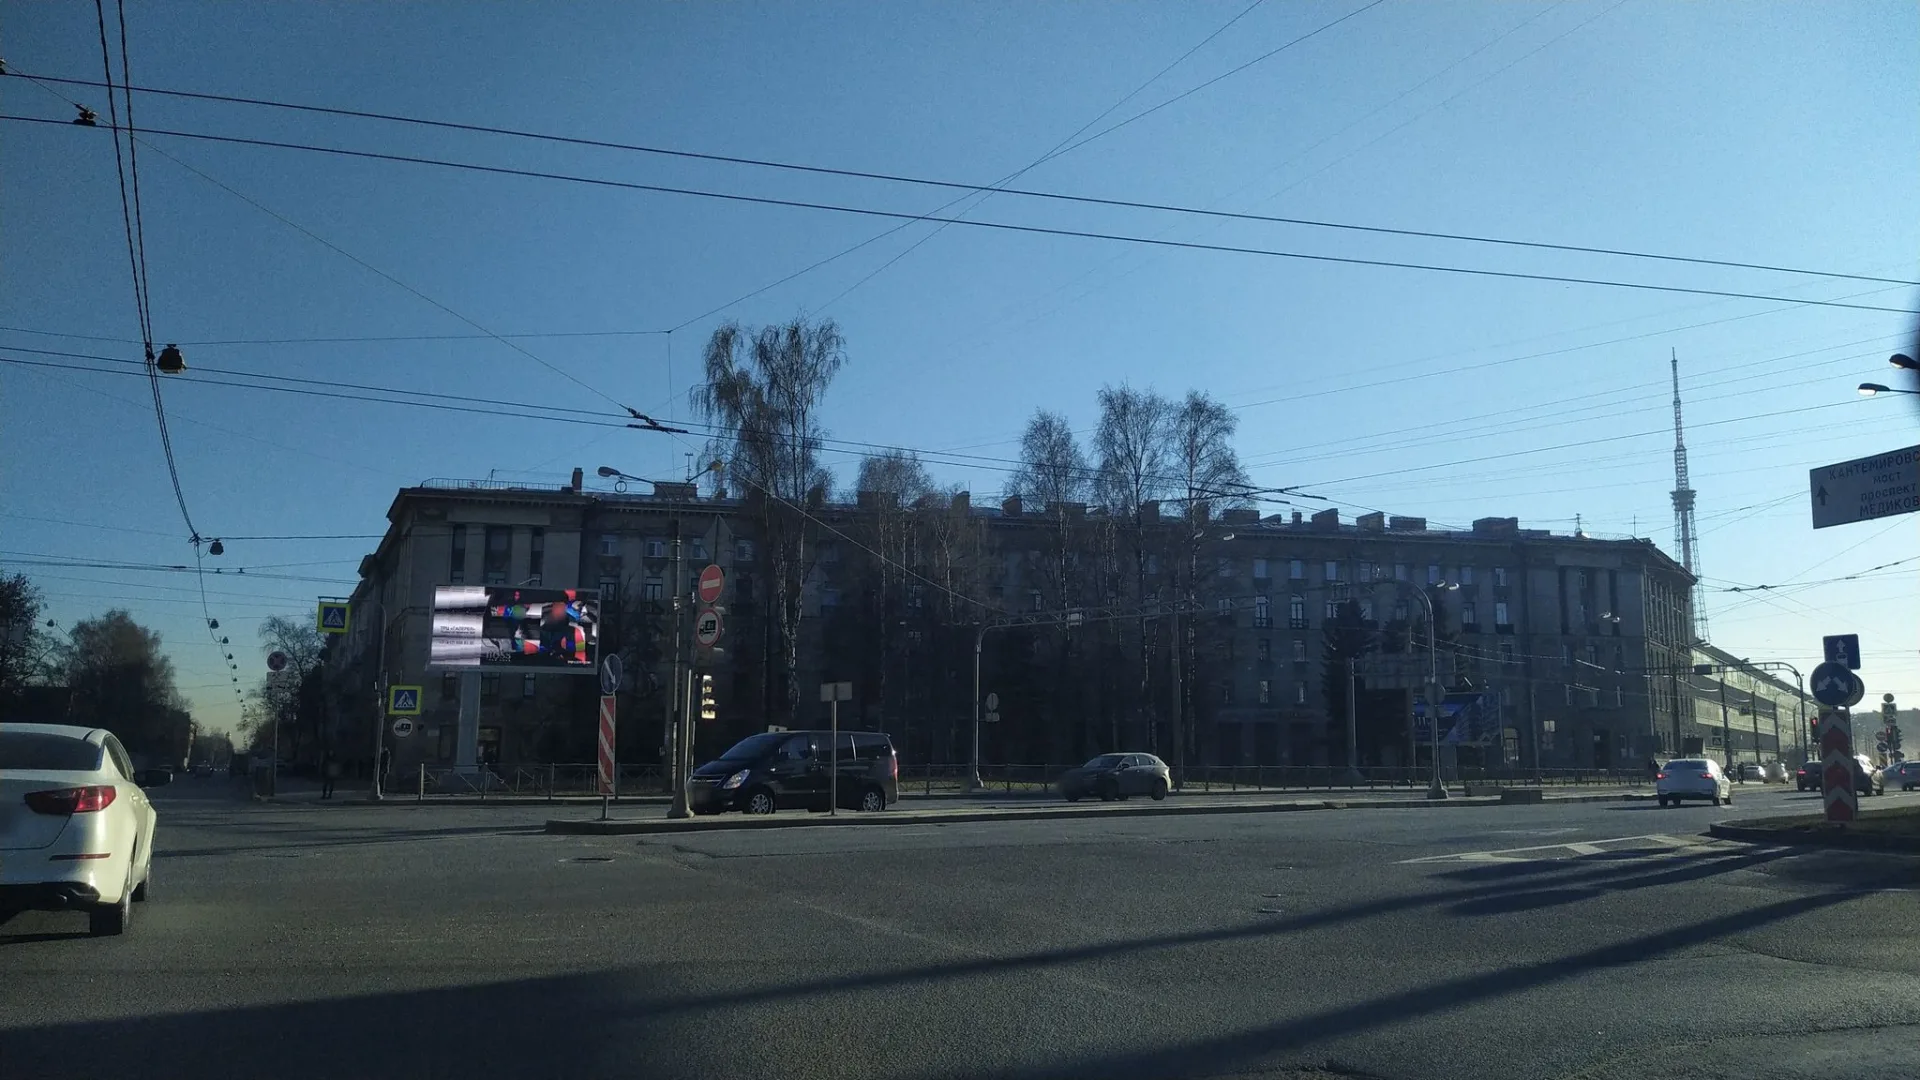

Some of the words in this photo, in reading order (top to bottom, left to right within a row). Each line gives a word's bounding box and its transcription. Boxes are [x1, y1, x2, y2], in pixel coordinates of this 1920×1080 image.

[1873, 472, 1901, 484] мост
[1861, 483, 1916, 502] проспект
[1860, 495, 1920, 517] МЕДИКОВ
